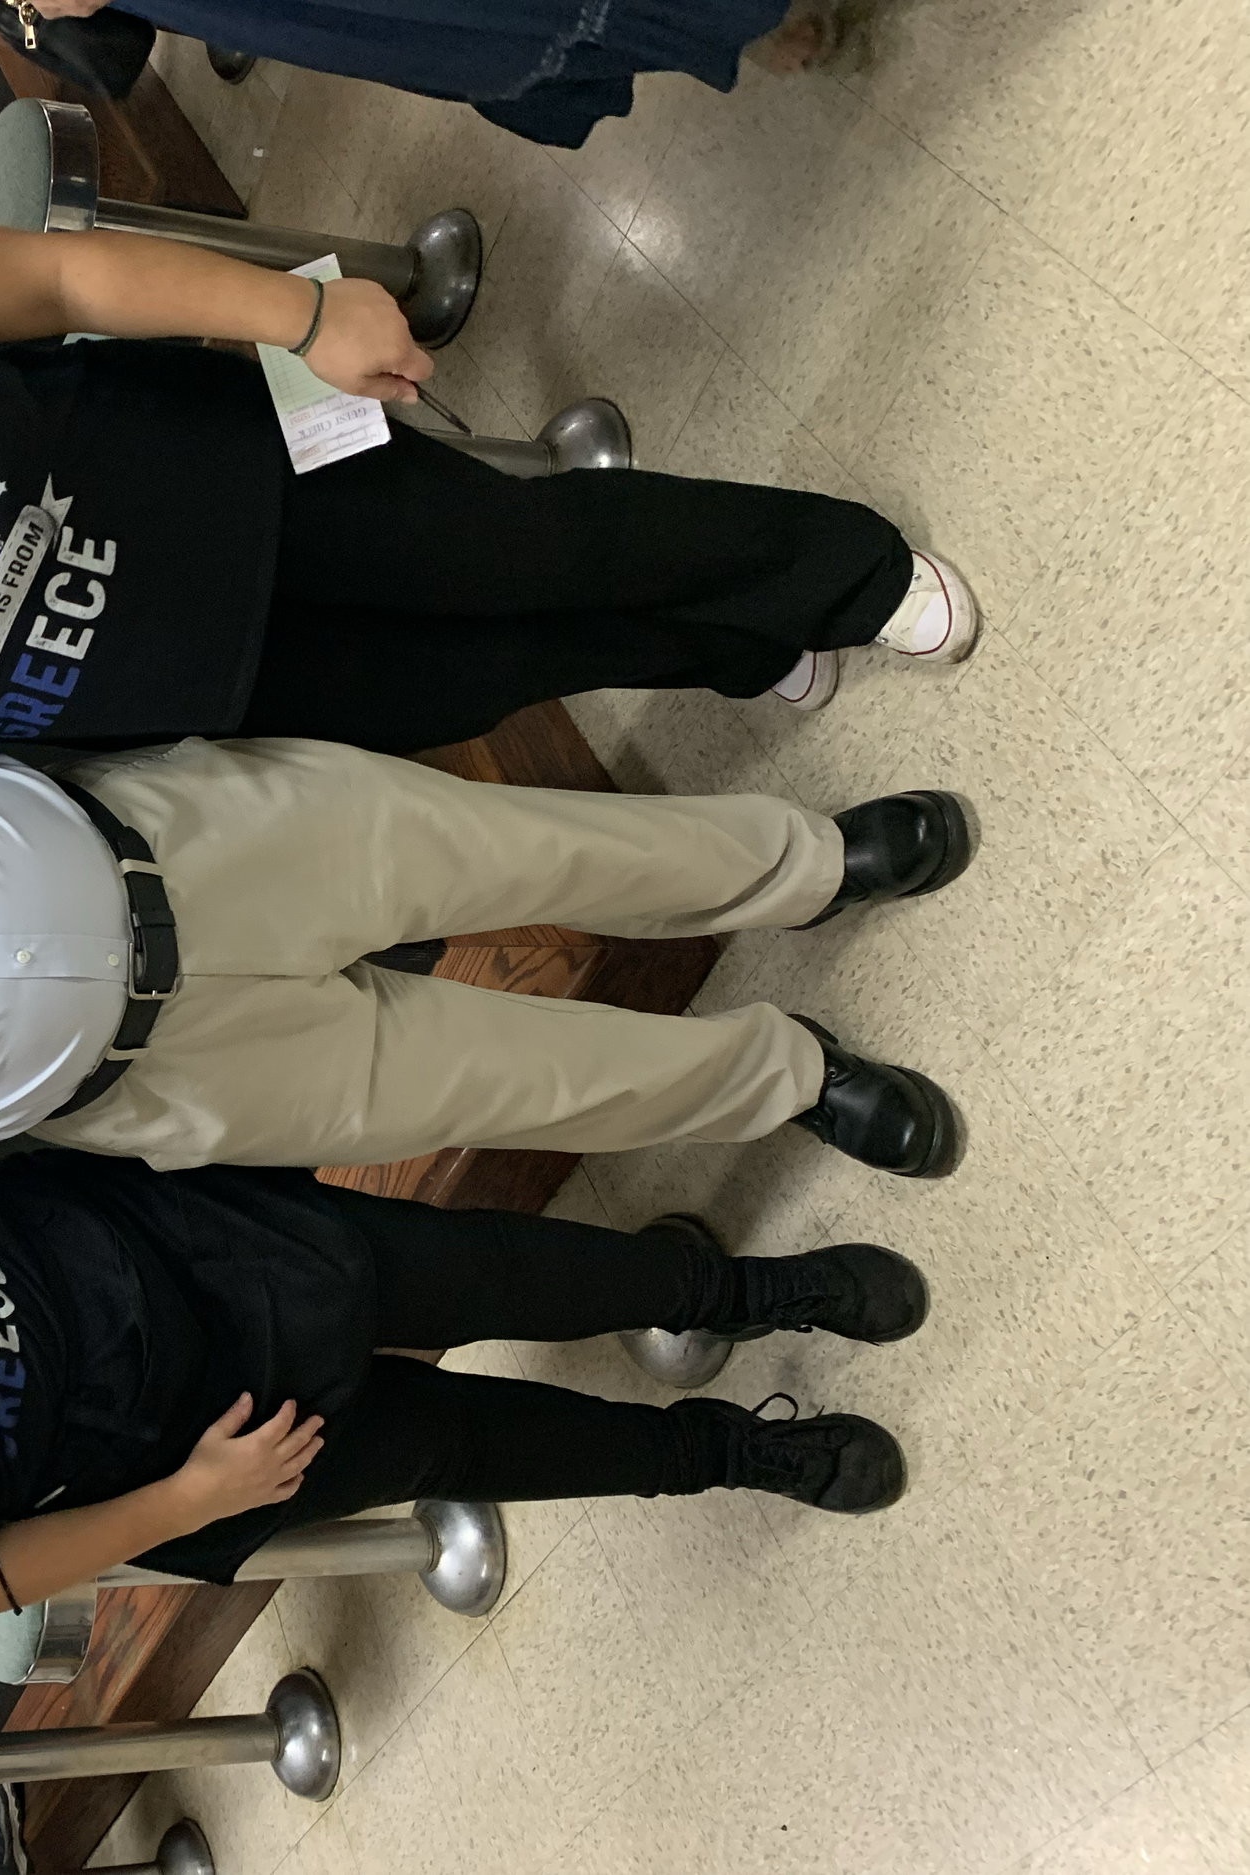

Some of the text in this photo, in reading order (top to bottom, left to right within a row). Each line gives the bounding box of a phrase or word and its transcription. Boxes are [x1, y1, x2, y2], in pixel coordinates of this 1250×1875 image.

[334, 407, 367, 424] GUEST
[298, 420, 332, 438] CHECK
[1, 520, 45, 588] FROM
